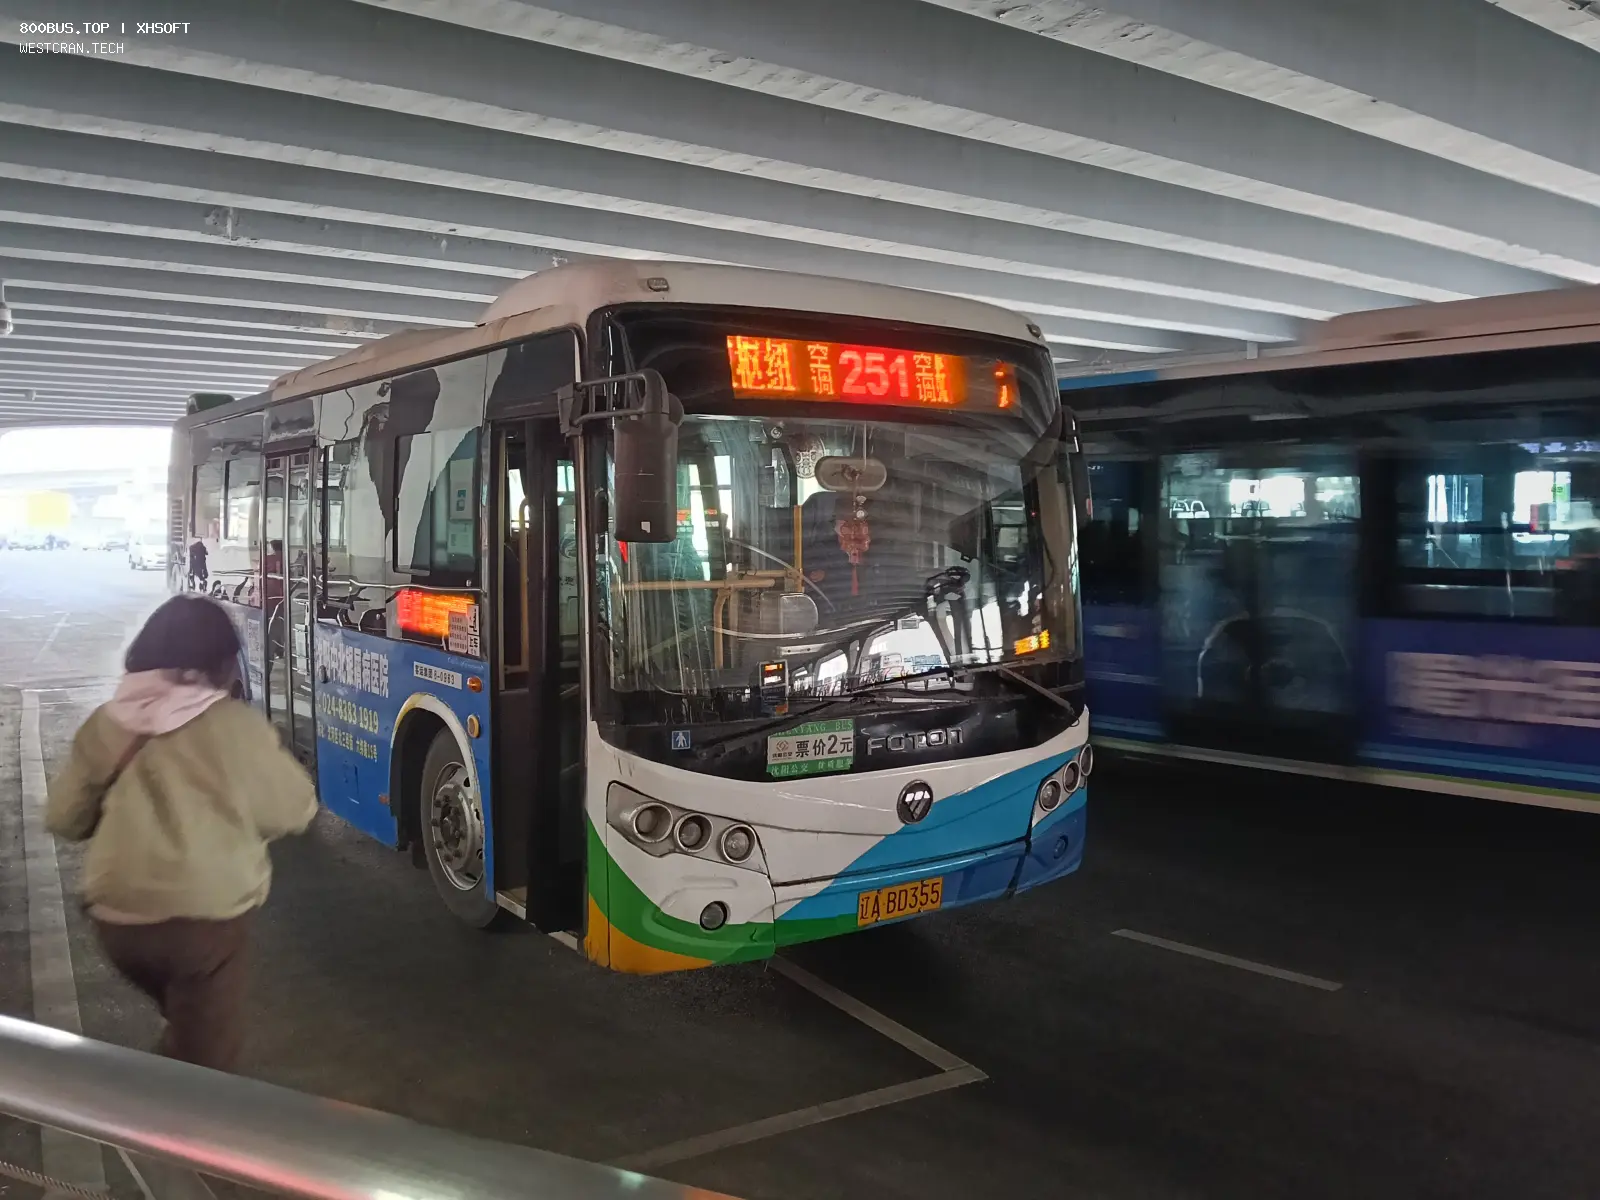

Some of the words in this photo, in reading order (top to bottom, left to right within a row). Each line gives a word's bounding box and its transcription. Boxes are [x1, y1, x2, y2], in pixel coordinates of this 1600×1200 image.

[838, 349, 910, 398] 251
[795, 734, 853, 758] 票价2元
[866, 726, 964, 755] FOTON
